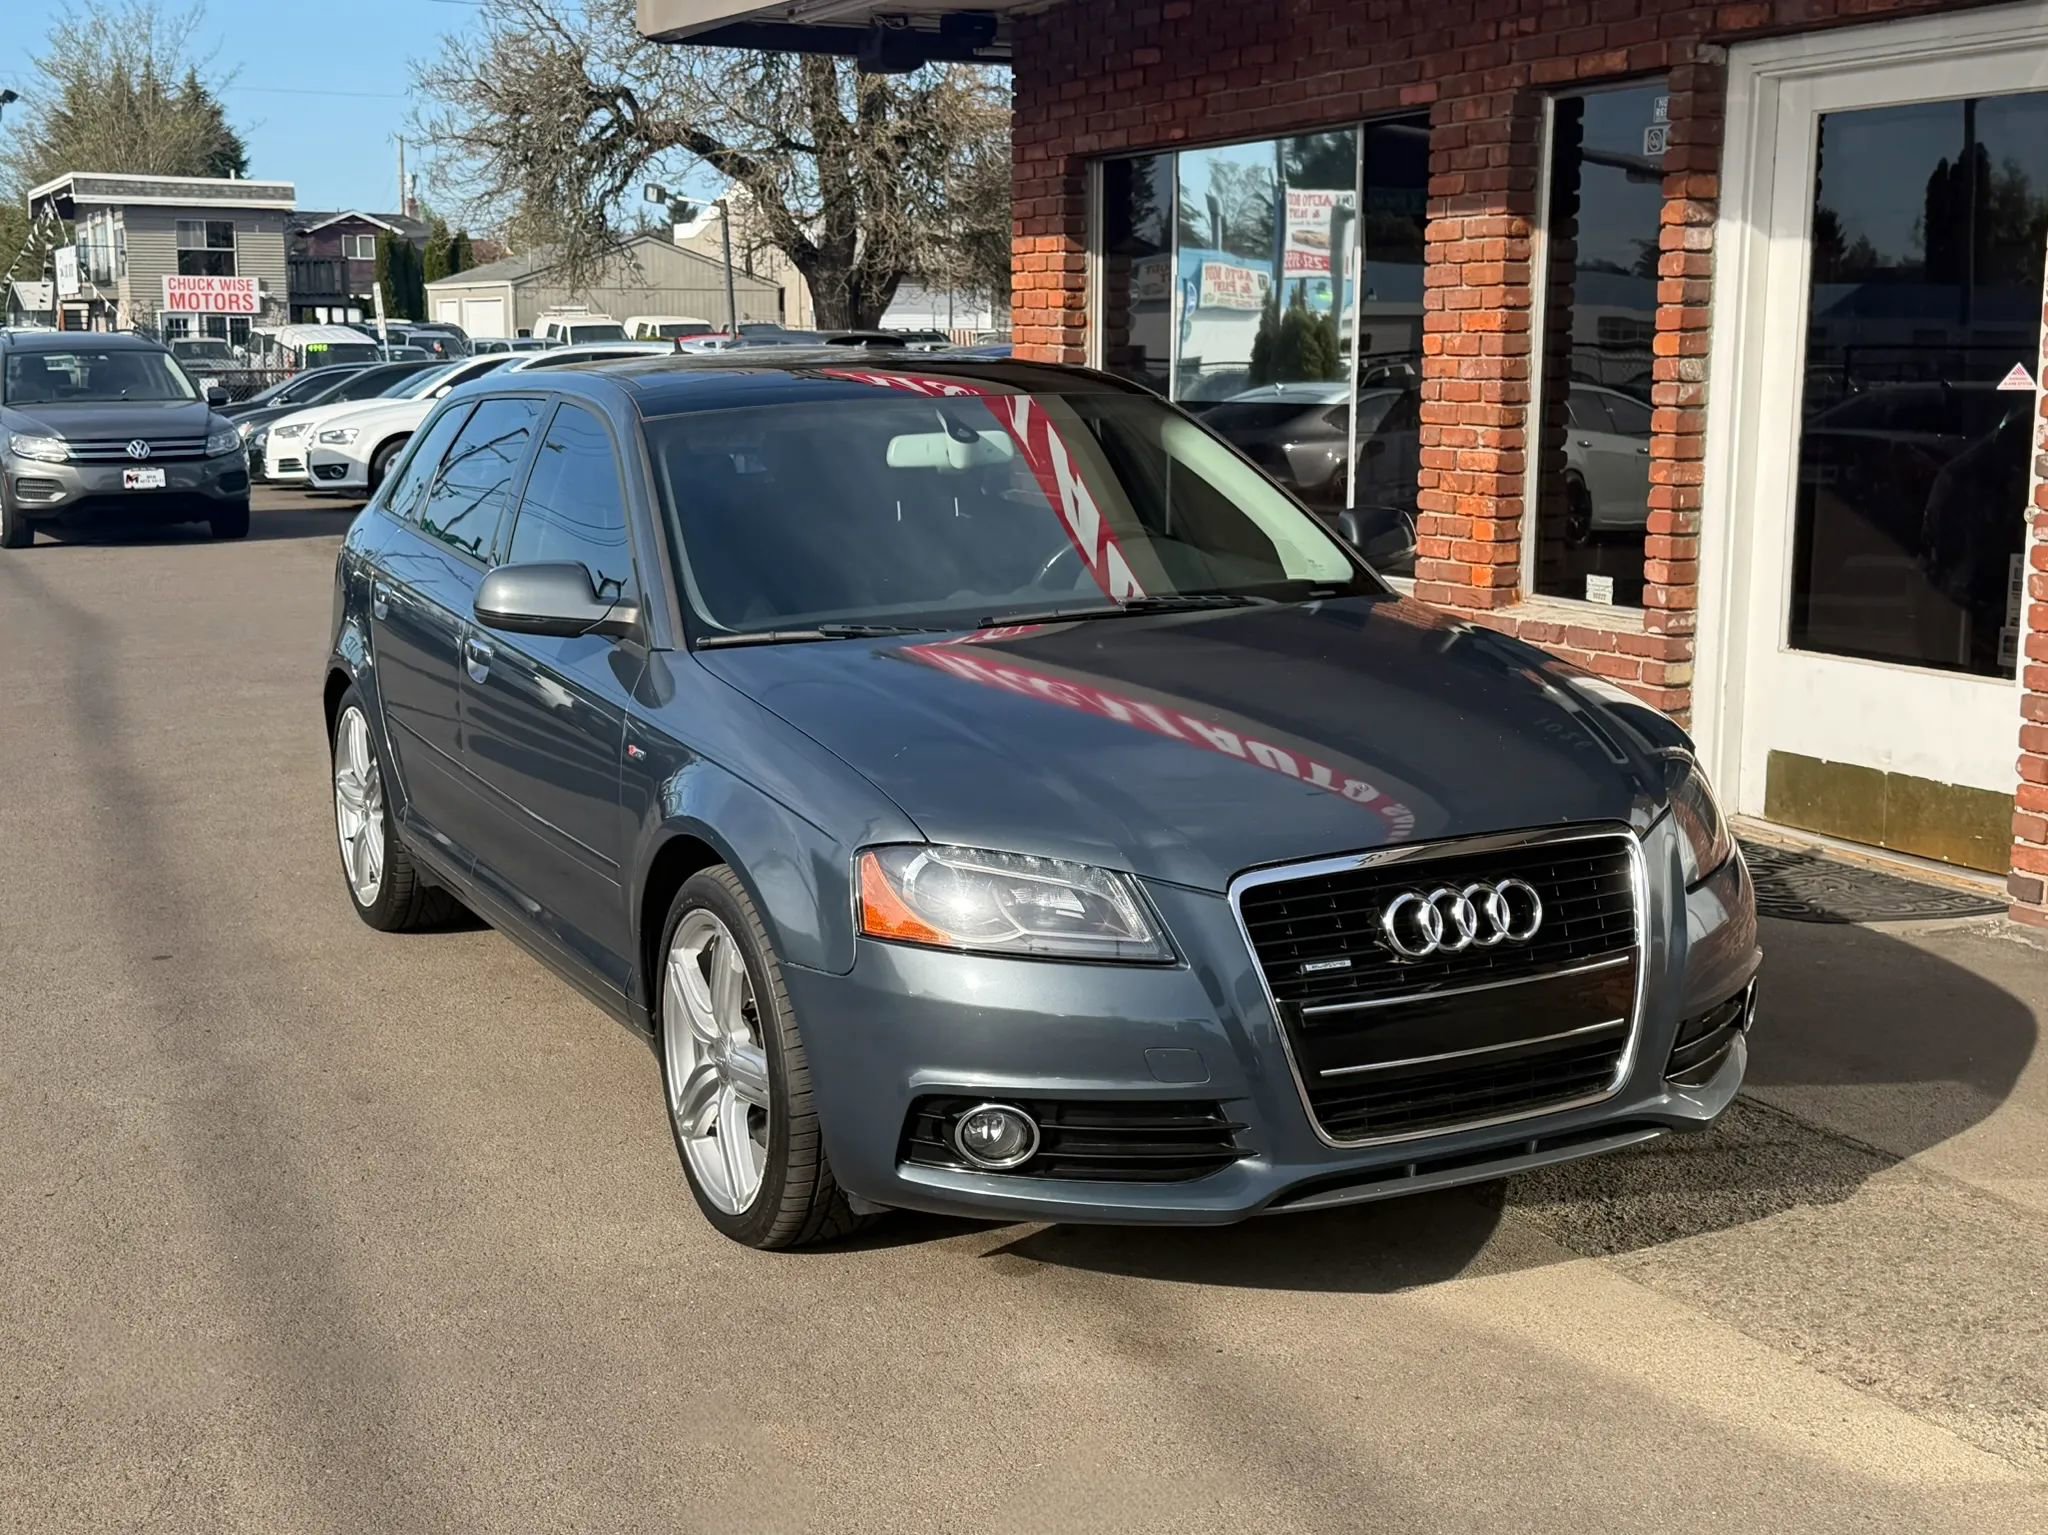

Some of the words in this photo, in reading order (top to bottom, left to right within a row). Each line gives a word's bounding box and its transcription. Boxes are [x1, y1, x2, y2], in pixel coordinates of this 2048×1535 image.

[168, 277, 215, 291] CHUCK
[219, 279, 254, 292] WISE
[169, 292, 254, 311] MOTORS
